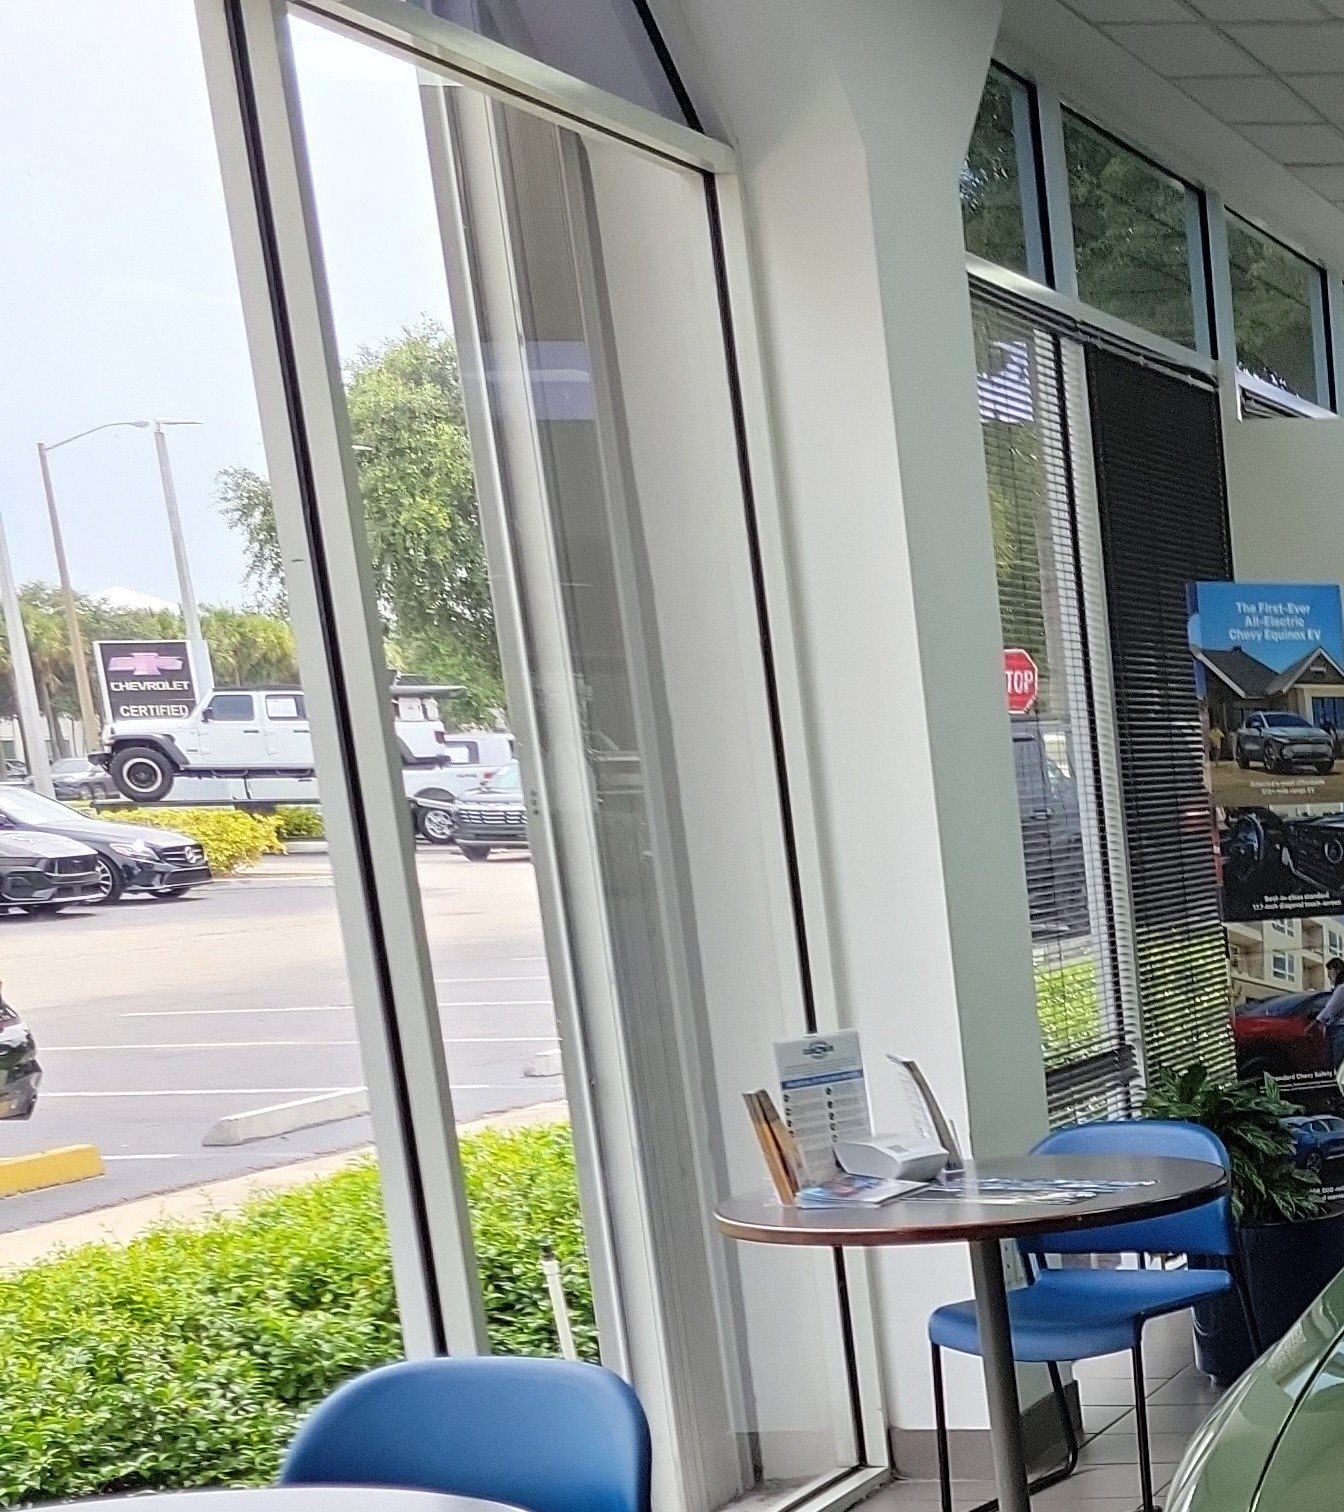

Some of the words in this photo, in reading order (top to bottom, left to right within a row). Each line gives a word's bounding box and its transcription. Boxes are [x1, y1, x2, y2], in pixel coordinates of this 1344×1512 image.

[1235, 602, 1257, 614] The
[1258, 602, 1310, 615] First-Ever
[1244, 615, 1305, 628] All-Electric
[1229, 628, 1262, 641] Chevy
[1264, 629, 1306, 642] Equinox
[1307, 629, 1321, 640] EV
[109, 681, 190, 692] CHEVROLET
[1005, 669, 1034, 694] TOP
[120, 704, 189, 719] CERTIFIED
